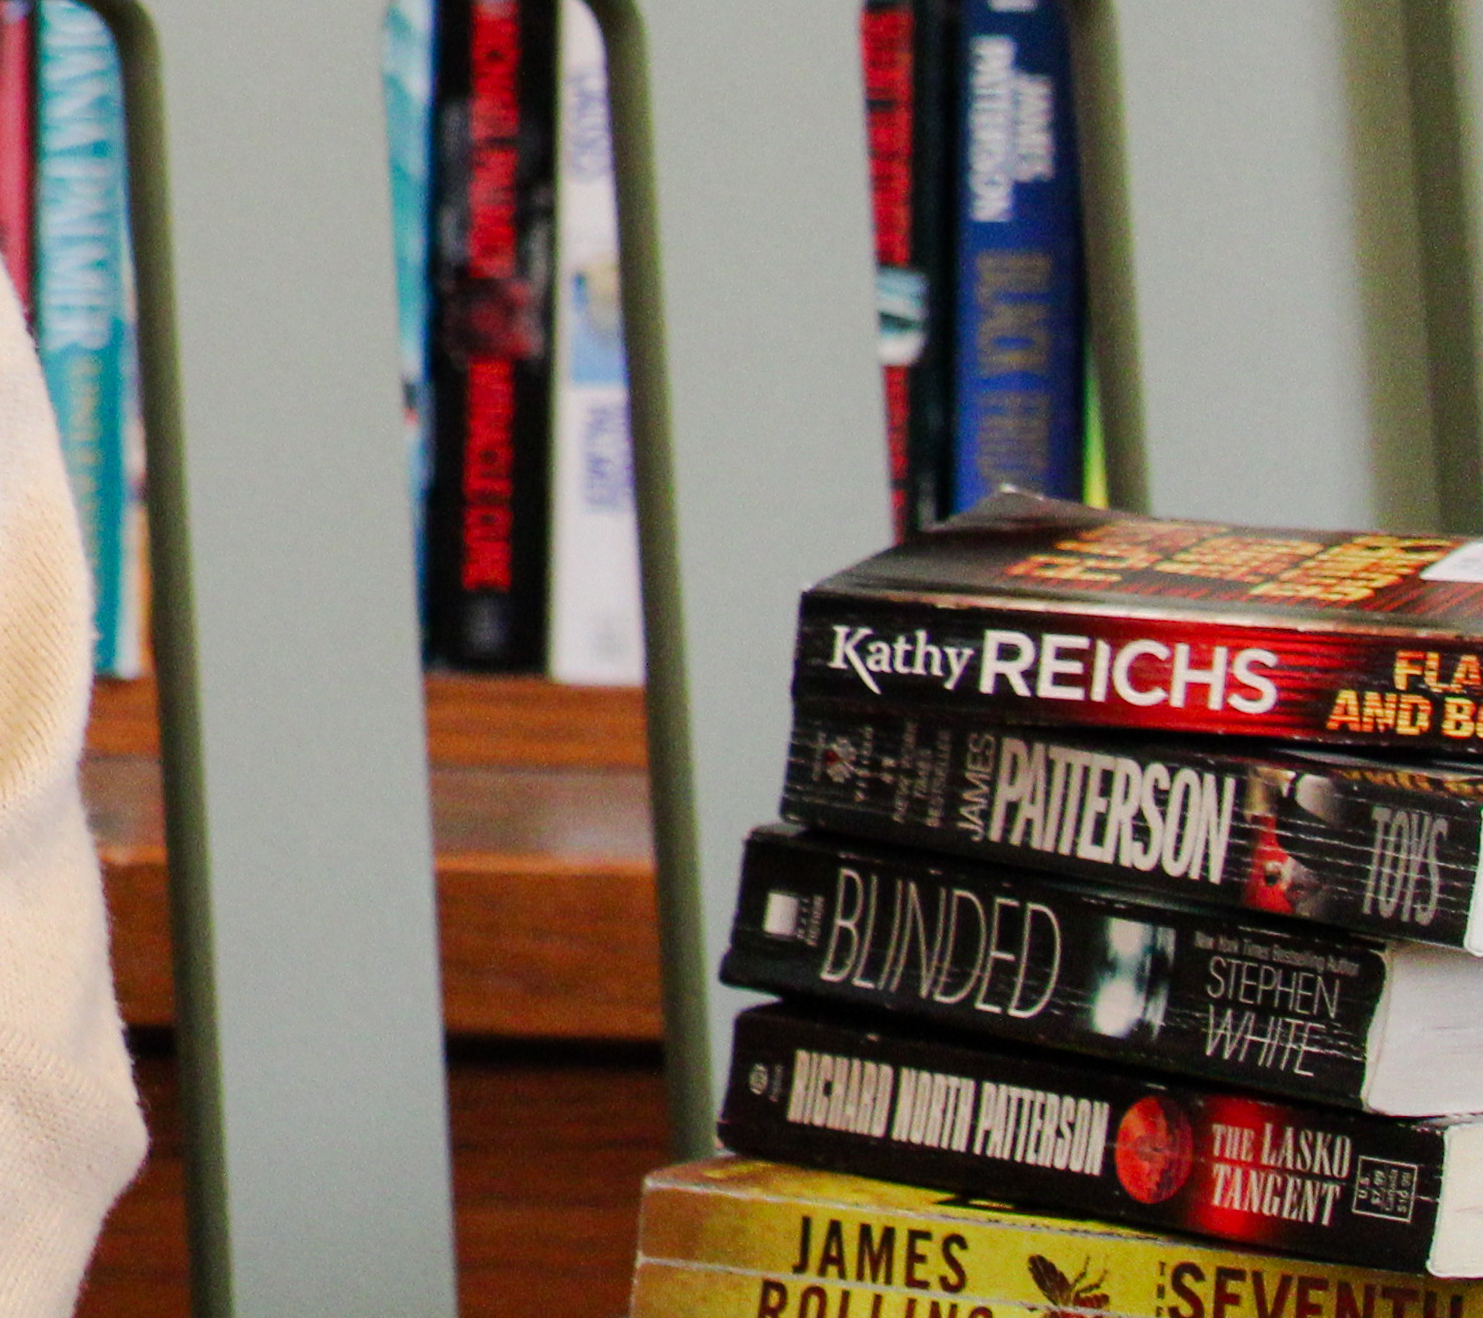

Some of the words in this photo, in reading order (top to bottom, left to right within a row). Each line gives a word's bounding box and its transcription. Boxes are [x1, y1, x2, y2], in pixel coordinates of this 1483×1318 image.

[828, 624, 974, 697] Kathy
[978, 628, 1280, 716] REICHS
[1324, 689, 1433, 738] AND
[957, 730, 997, 843] JAMES
[987, 737, 1236, 886] PATTERSON
[1363, 806, 1449, 926] TOYS
[819, 867, 1063, 1019] BLINDED
[1207, 954, 1341, 1020] STEPHEN
[1205, 1003, 1327, 1078] WHITE
[785, 1048, 893, 1140] RICHARD
[892, 1065, 978, 1152] NORTH
[971, 1075, 1113, 1178] PATTERSON
[1211, 1121, 1256, 1162] THE
[1258, 1120, 1353, 1181] LASKO
[1210, 1161, 1342, 1229] TANGENT
[790, 1214, 971, 1294] JAMES
